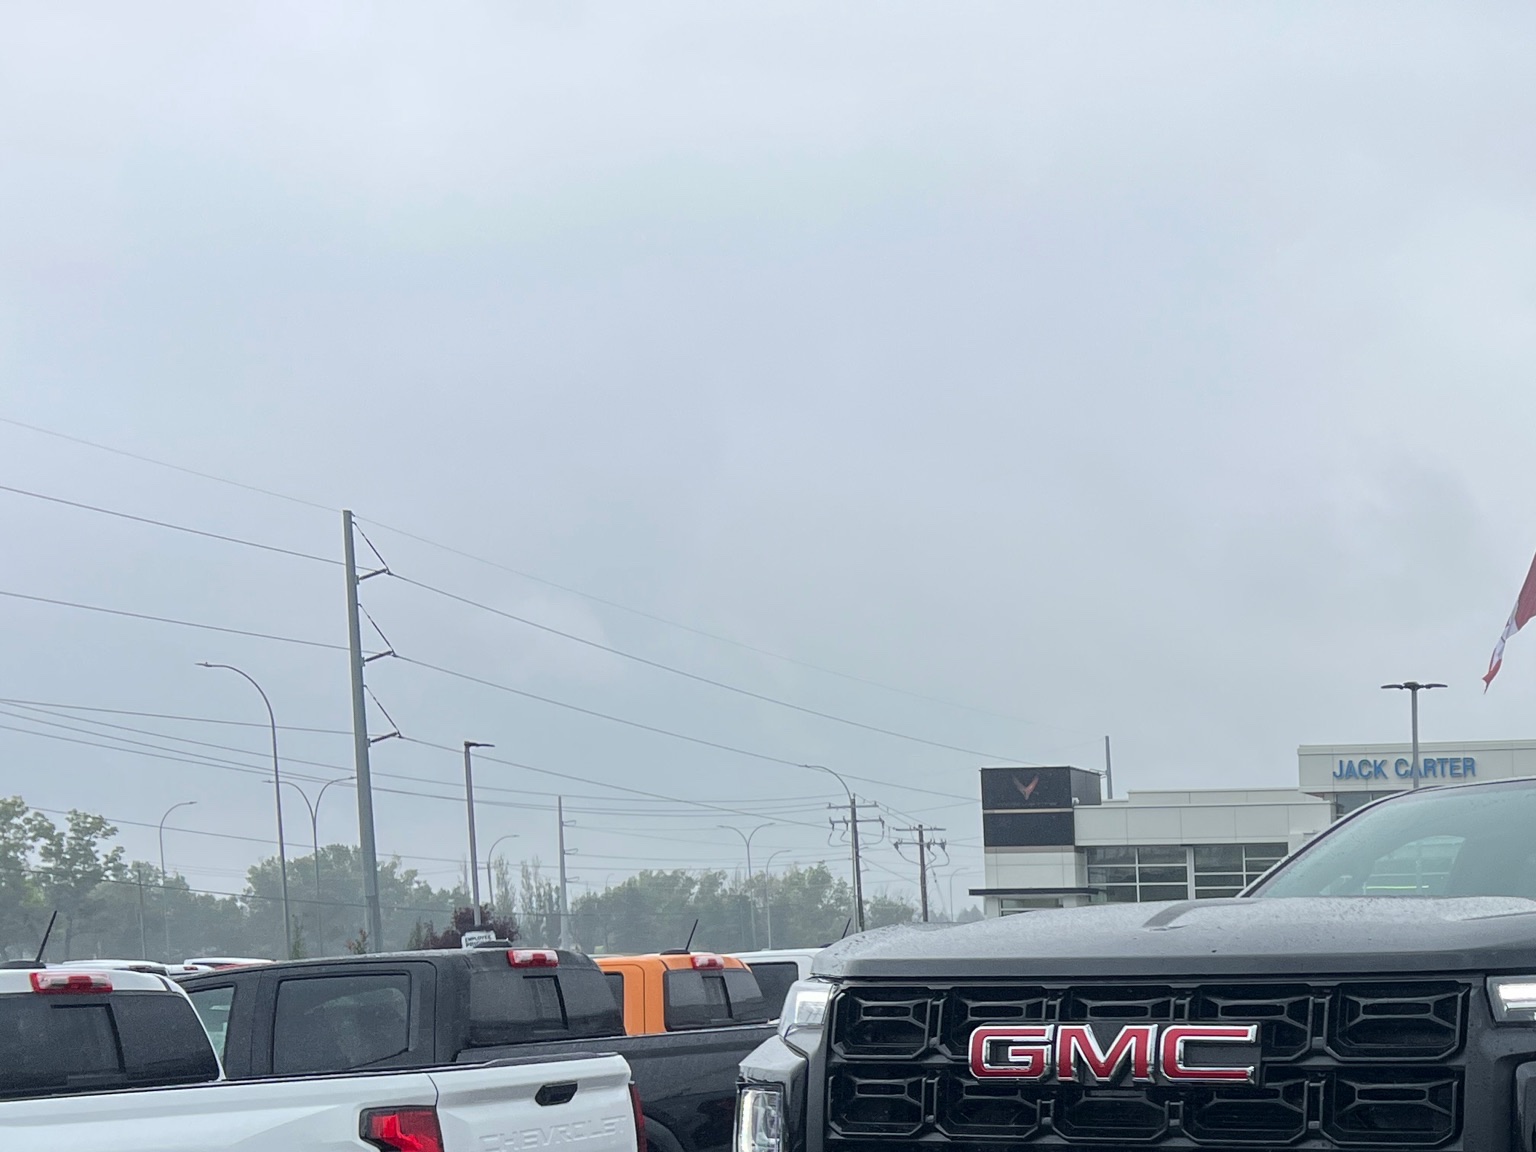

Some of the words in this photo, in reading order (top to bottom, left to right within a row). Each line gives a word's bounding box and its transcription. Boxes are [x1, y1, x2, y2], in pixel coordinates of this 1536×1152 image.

[1333, 759, 1388, 779] JACK
[1395, 757, 1476, 779] CARTER
[968, 1024, 1262, 1083] GMC
